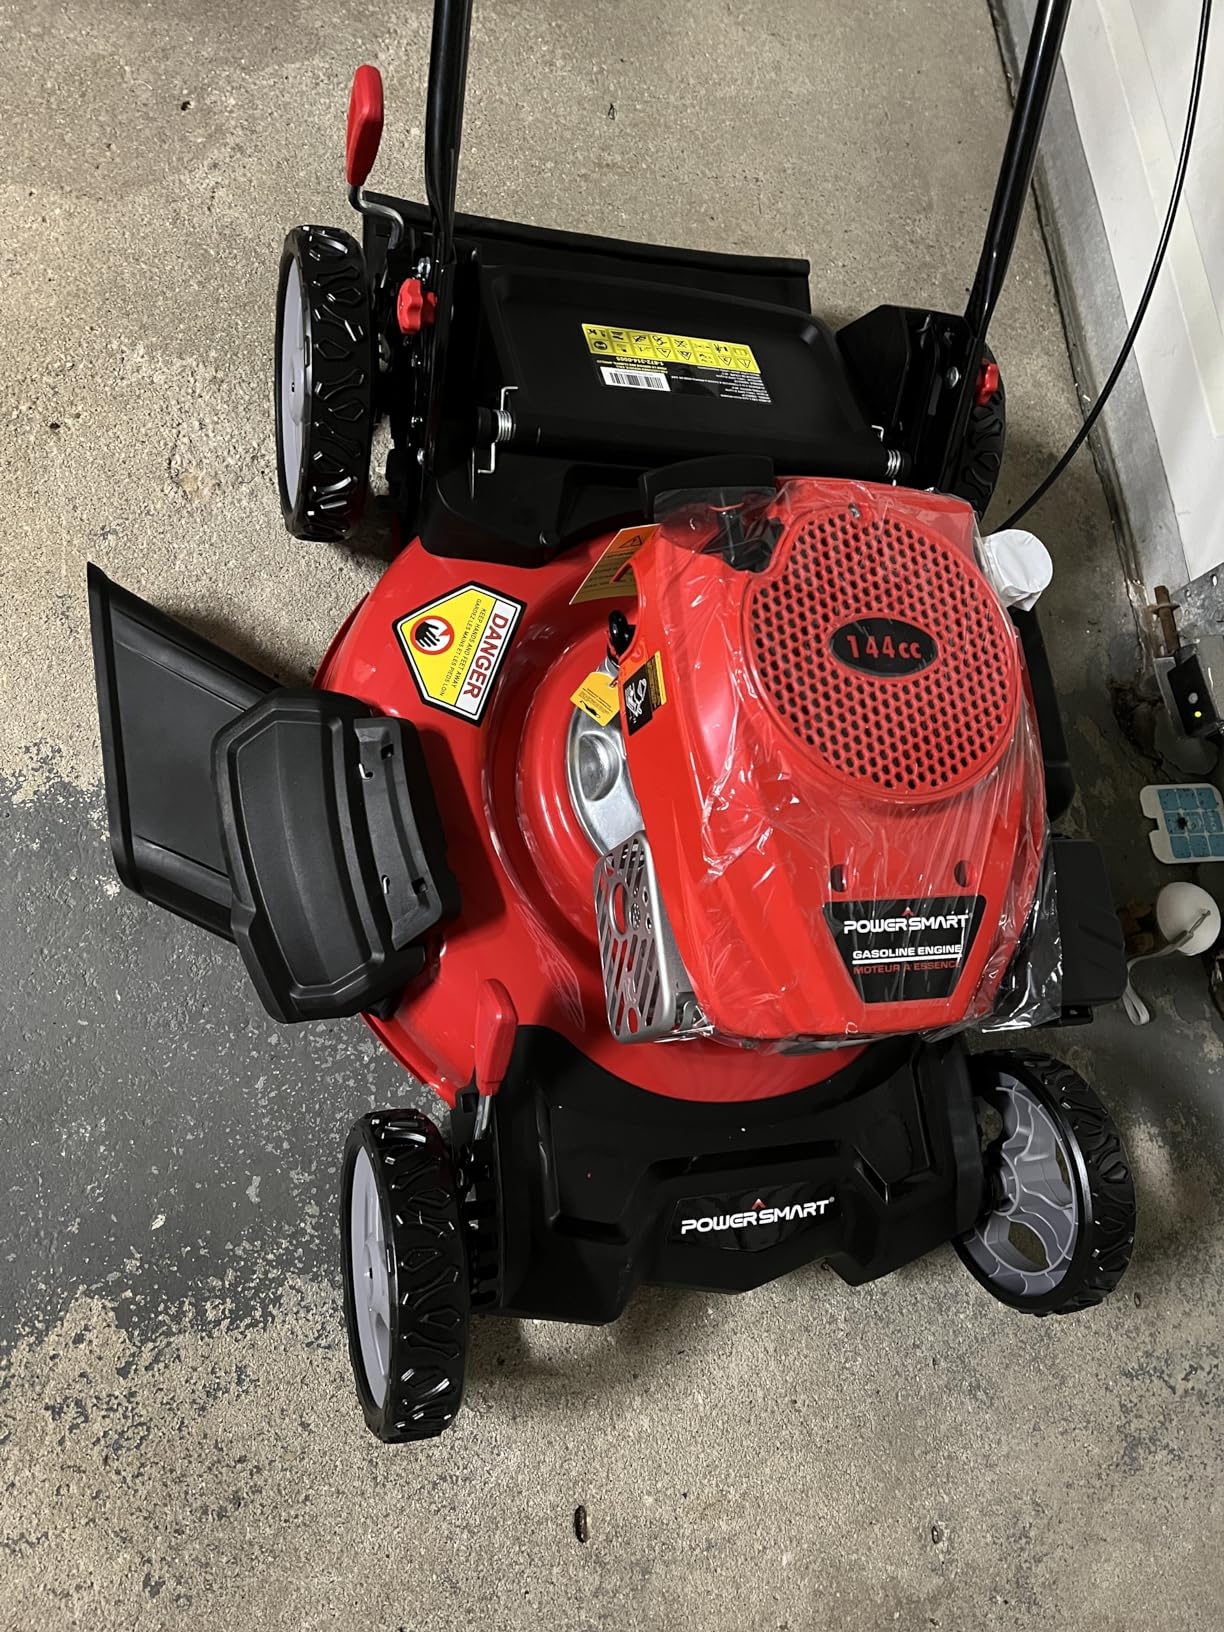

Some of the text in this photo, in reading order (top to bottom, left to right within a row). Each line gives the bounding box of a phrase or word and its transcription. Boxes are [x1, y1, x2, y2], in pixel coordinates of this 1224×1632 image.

[439, 598, 482, 697] GARDEZ LES MAINS ET LES PIEDS LOIN
[451, 607, 487, 688] KEEP HANDS AND FEET AWAY
[463, 612, 509, 699] DANGER
[846, 635, 922, 660] 144cc
[843, 914, 969, 935] POWERSMART
[852, 944, 962, 959] GASOLINE ENGINE
[853, 964, 900, 975] MOTEUR
